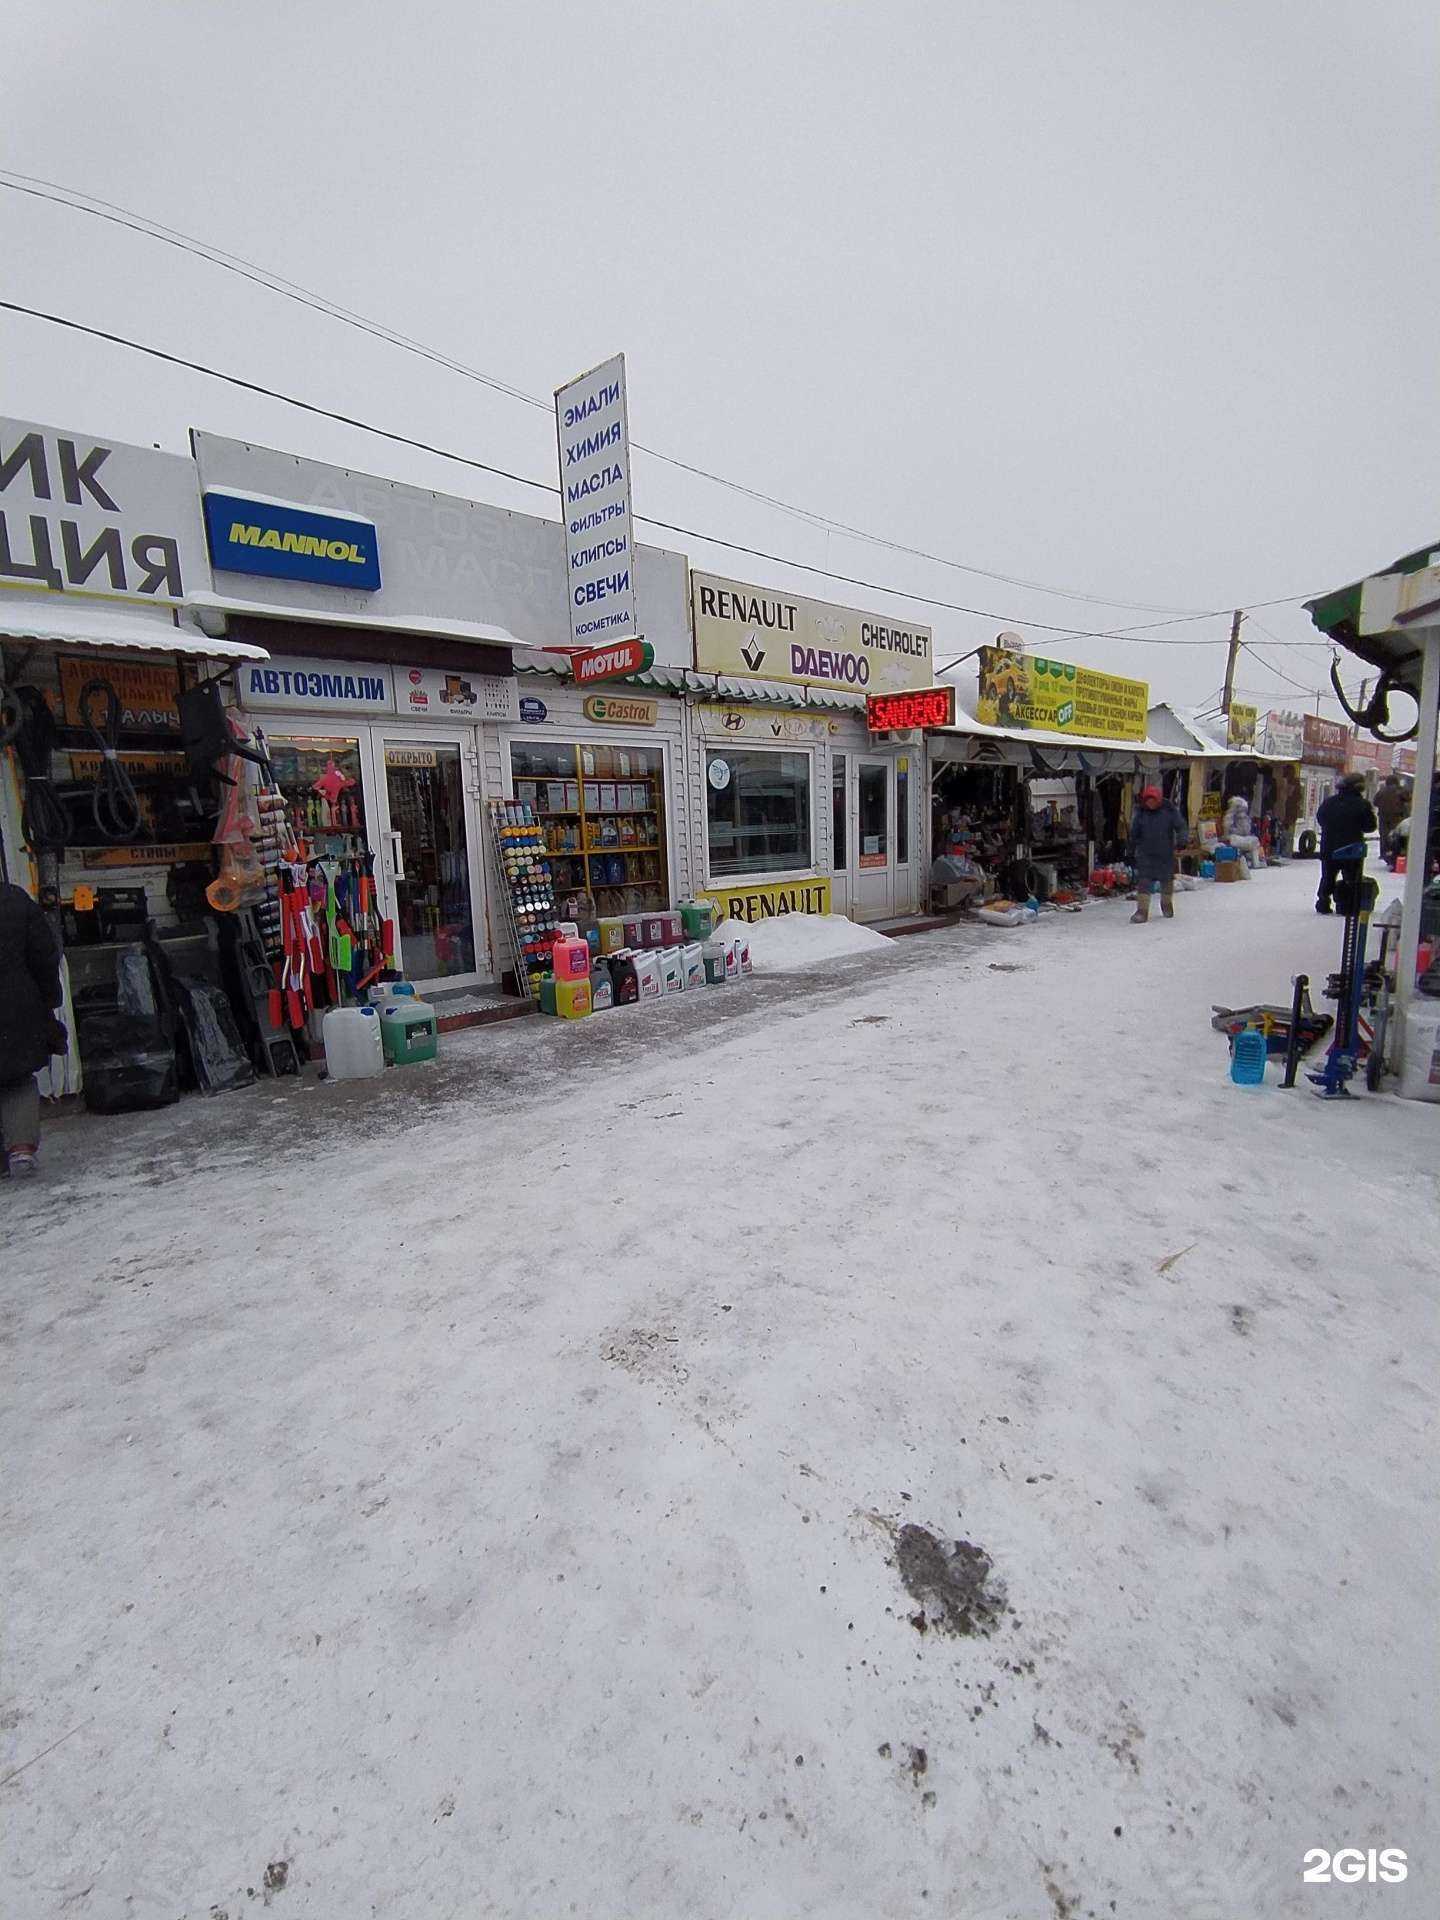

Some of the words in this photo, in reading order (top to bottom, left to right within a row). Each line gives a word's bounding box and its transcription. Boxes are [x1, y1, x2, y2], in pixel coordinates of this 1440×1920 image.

[564, 381, 620, 428] ЭМАЛИ
[566, 421, 621, 466] ХИМИЯ
[568, 463, 623, 503] МАСЛА
[570, 500, 626, 534] ФИЛЬТРЫ
[228, 522, 367, 564] MANNOL
[571, 535, 627, 569] КЛИПСЫ
[574, 570, 630, 606] СВЕЧИ
[575, 610, 630, 636] КОСМЕТИКА
[700, 586, 797, 631] RENAULT
[861, 623, 929, 658] CHEVROLET
[581, 648, 633, 678] MOTUL
[791, 643, 870, 686] DAEWOO
[250, 668, 385, 701] АВТОЭМАЛИ
[607, 703, 650, 721] Castrol
[388, 750, 433, 765] ОТКРЫТО
[729, 886, 827, 922] RENAULT
